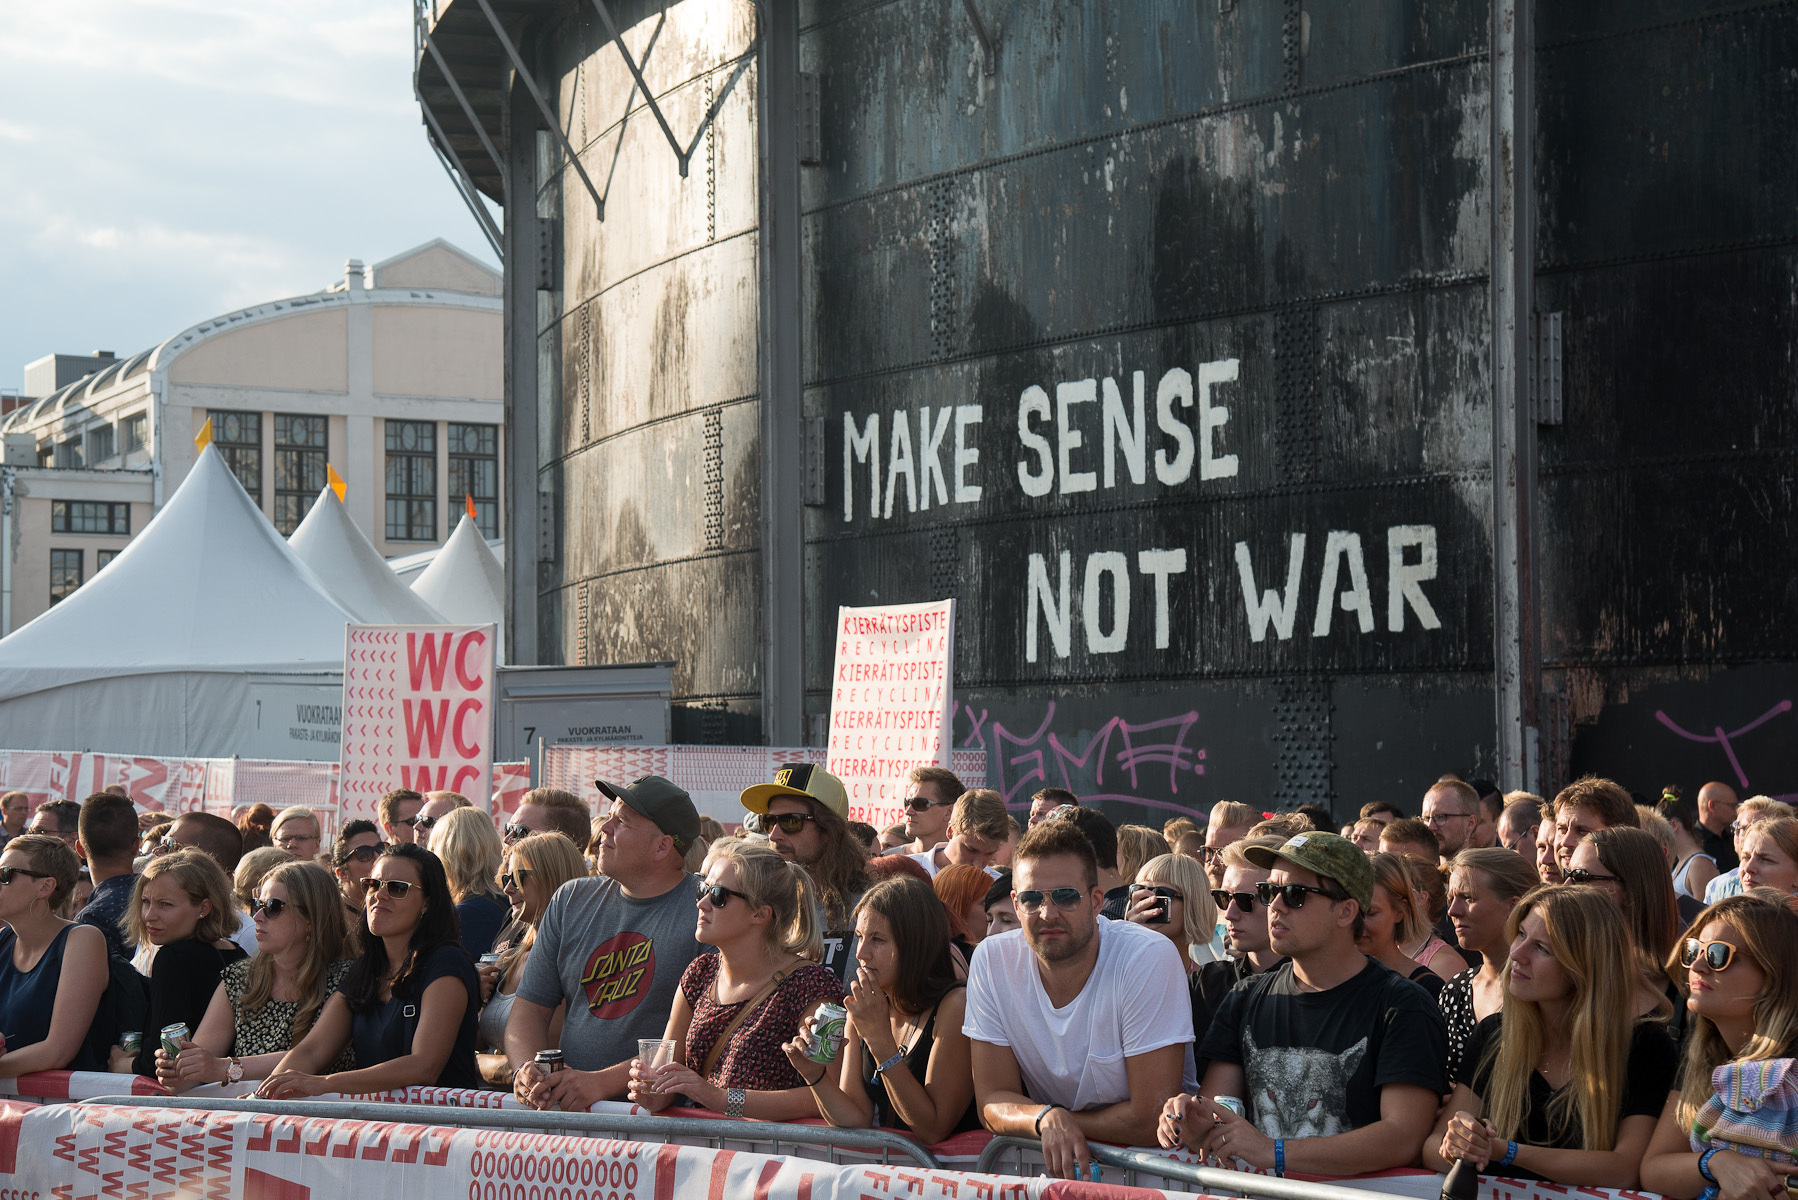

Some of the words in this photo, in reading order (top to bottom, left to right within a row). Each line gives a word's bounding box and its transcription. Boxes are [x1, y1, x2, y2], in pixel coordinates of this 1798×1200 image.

[844, 404, 983, 522] MAKE
[1017, 357, 1240, 497] SENSE
[1026, 547, 1187, 663] NOT
[1235, 524, 1441, 642] WAR
[844, 611, 946, 635] KIERRÄTYSPISTE
[841, 636, 944, 655] RECYCLING
[406, 631, 486, 692] WC
[839, 659, 944, 682] KIERRÄTYSPISTE
[836, 686, 942, 703] RECYCLING
[402, 698, 483, 760] WC
[834, 707, 941, 729] KIERRÄTYSPISTE
[523, 726, 536, 745] 7
[568, 725, 632, 736] VUOKRATAAN
[832, 735, 941, 752] RECYCLING
[831, 755, 941, 779] KIERRÄTYSPI
[580, 938, 653, 984] SANTA
[588, 967, 646, 1009] CRUZ
